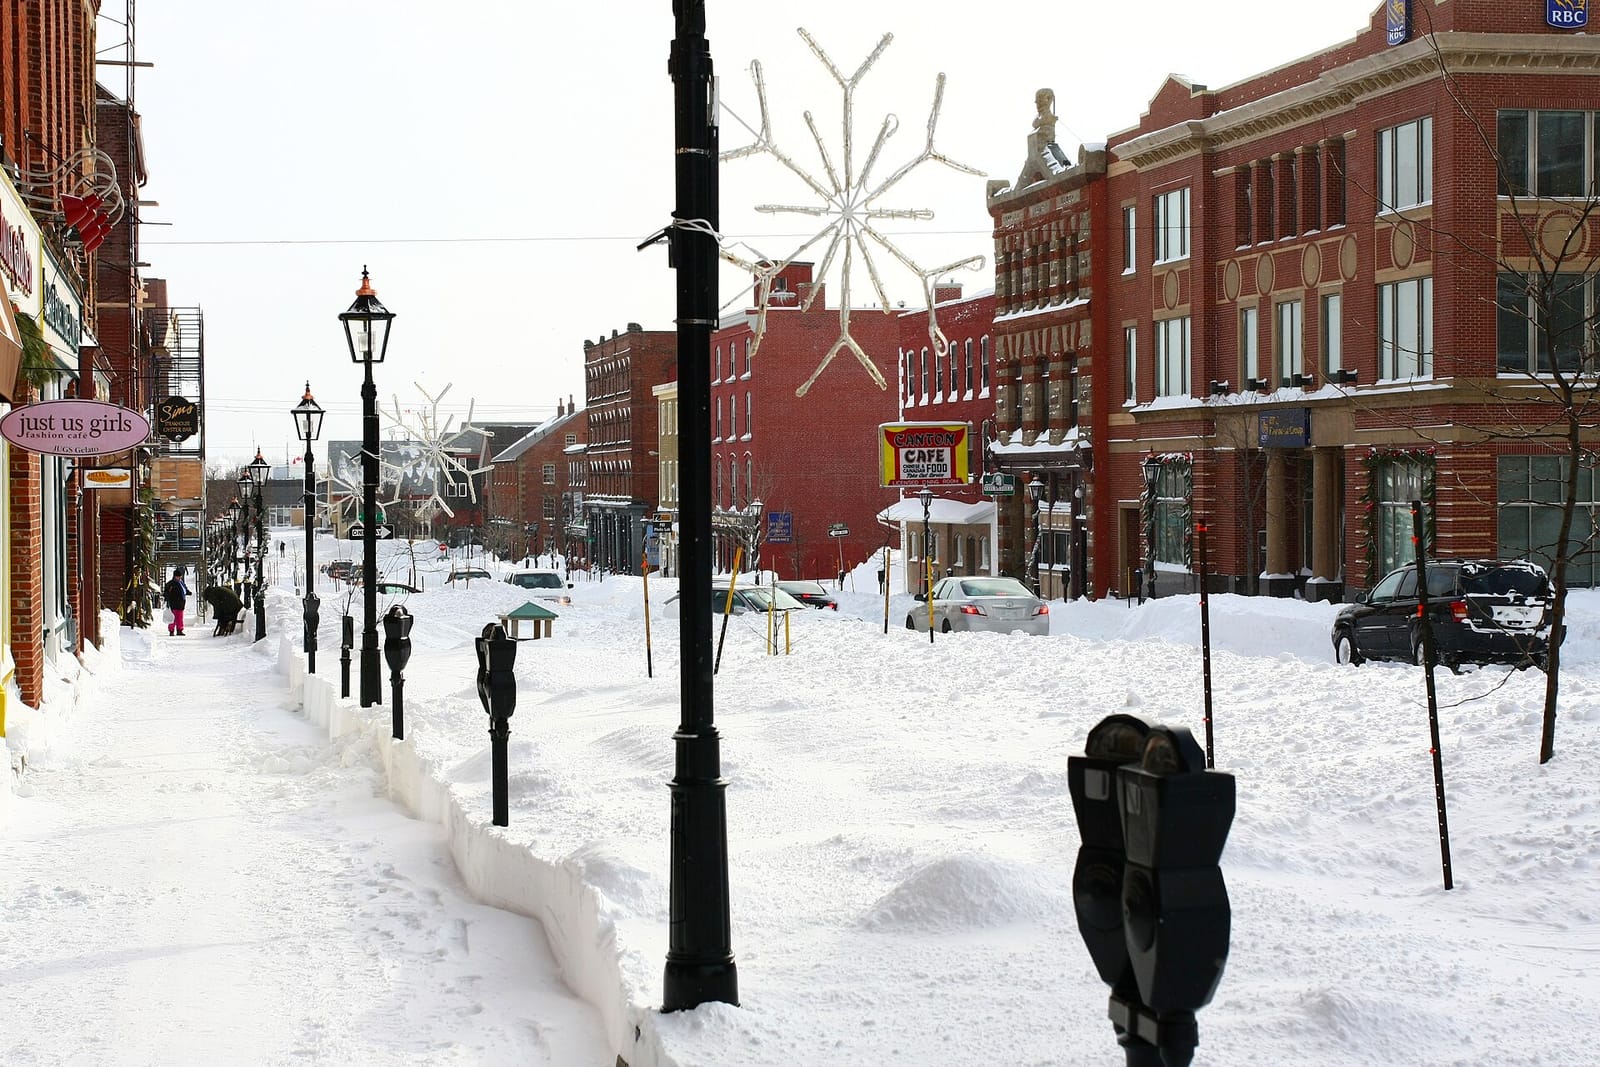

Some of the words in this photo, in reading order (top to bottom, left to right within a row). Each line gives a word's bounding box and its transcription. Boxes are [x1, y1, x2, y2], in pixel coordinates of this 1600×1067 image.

[1552, 10, 1584, 23] RBC
[1389, 25, 1404, 41] RBC
[160, 405, 194, 422] Sims
[16, 414, 55, 438] just
[61, 417, 84, 431] us
[89, 412, 132, 438] girls
[894, 432, 956, 447] CANTON
[904, 448, 945, 463] CAFE
[926, 464, 947, 472] FOOD
